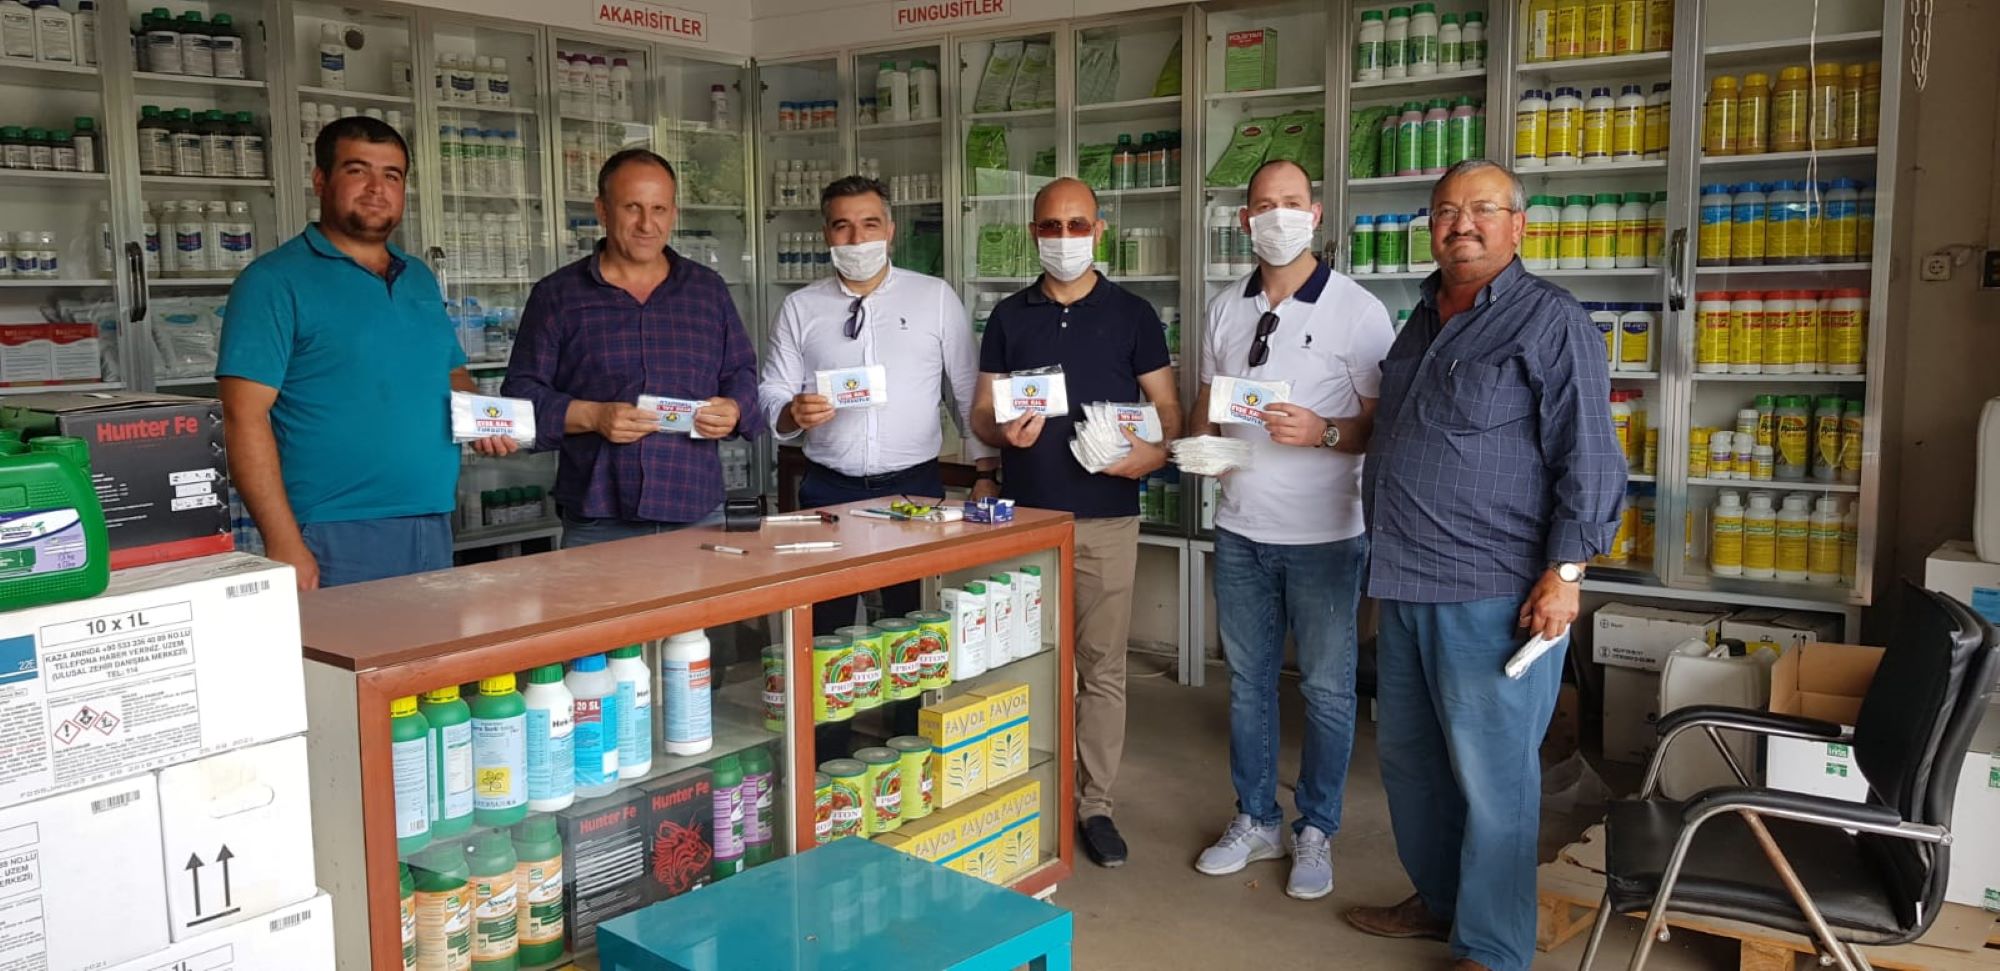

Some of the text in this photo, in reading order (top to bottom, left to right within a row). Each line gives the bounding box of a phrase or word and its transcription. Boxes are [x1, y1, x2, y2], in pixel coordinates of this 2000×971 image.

[600, 4, 702, 36] AKARİSİTLER
[97, 416, 198, 442] Hunter Fe
[86, 612, 150, 635] 10 x 1L
[577, 701, 600, 711] 20 SL
[652, 781, 710, 811] Hunter Fe
[580, 805, 637, 833] Hunter Fe
